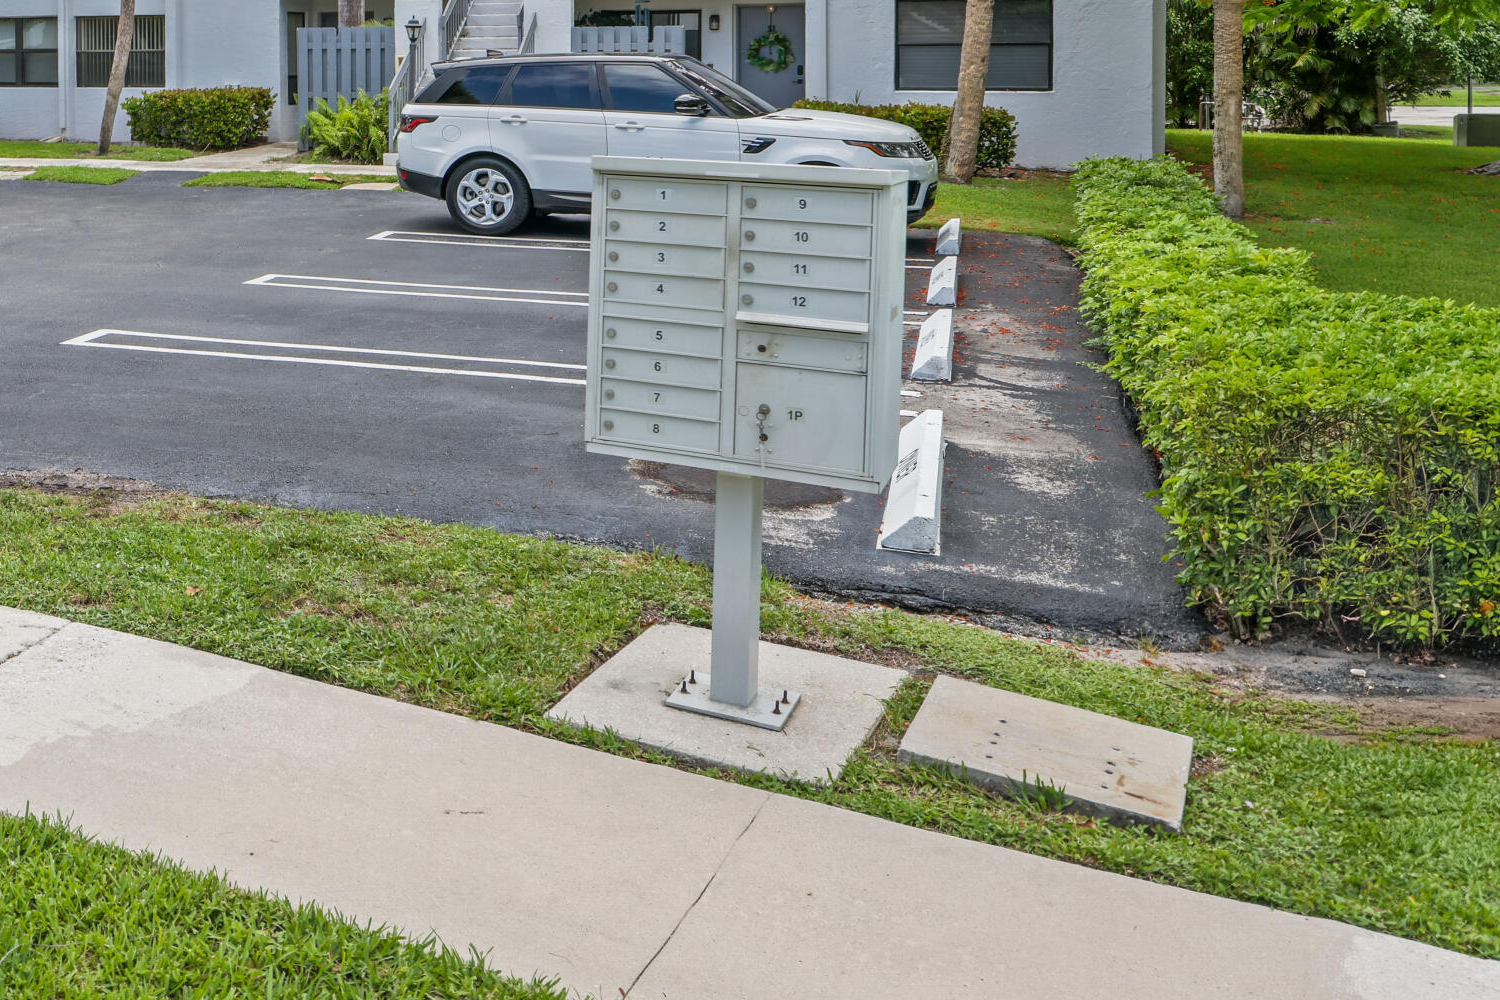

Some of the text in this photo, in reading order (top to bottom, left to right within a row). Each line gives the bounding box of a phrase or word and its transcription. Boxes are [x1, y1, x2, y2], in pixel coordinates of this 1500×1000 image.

[659, 190, 667, 201] 1
[798, 198, 807, 210] 9
[658, 221, 667, 232] 2
[793, 231, 809, 243] 10
[657, 252, 666, 263] 3
[793, 263, 807, 275] 11
[656, 283, 665, 294] 4
[791, 295, 807, 308] 12
[655, 330, 663, 341] 5
[653, 361, 662, 372] 6
[653, 392, 661, 403] 7
[787, 409, 804, 422] 1P
[652, 423, 660, 434] 8
